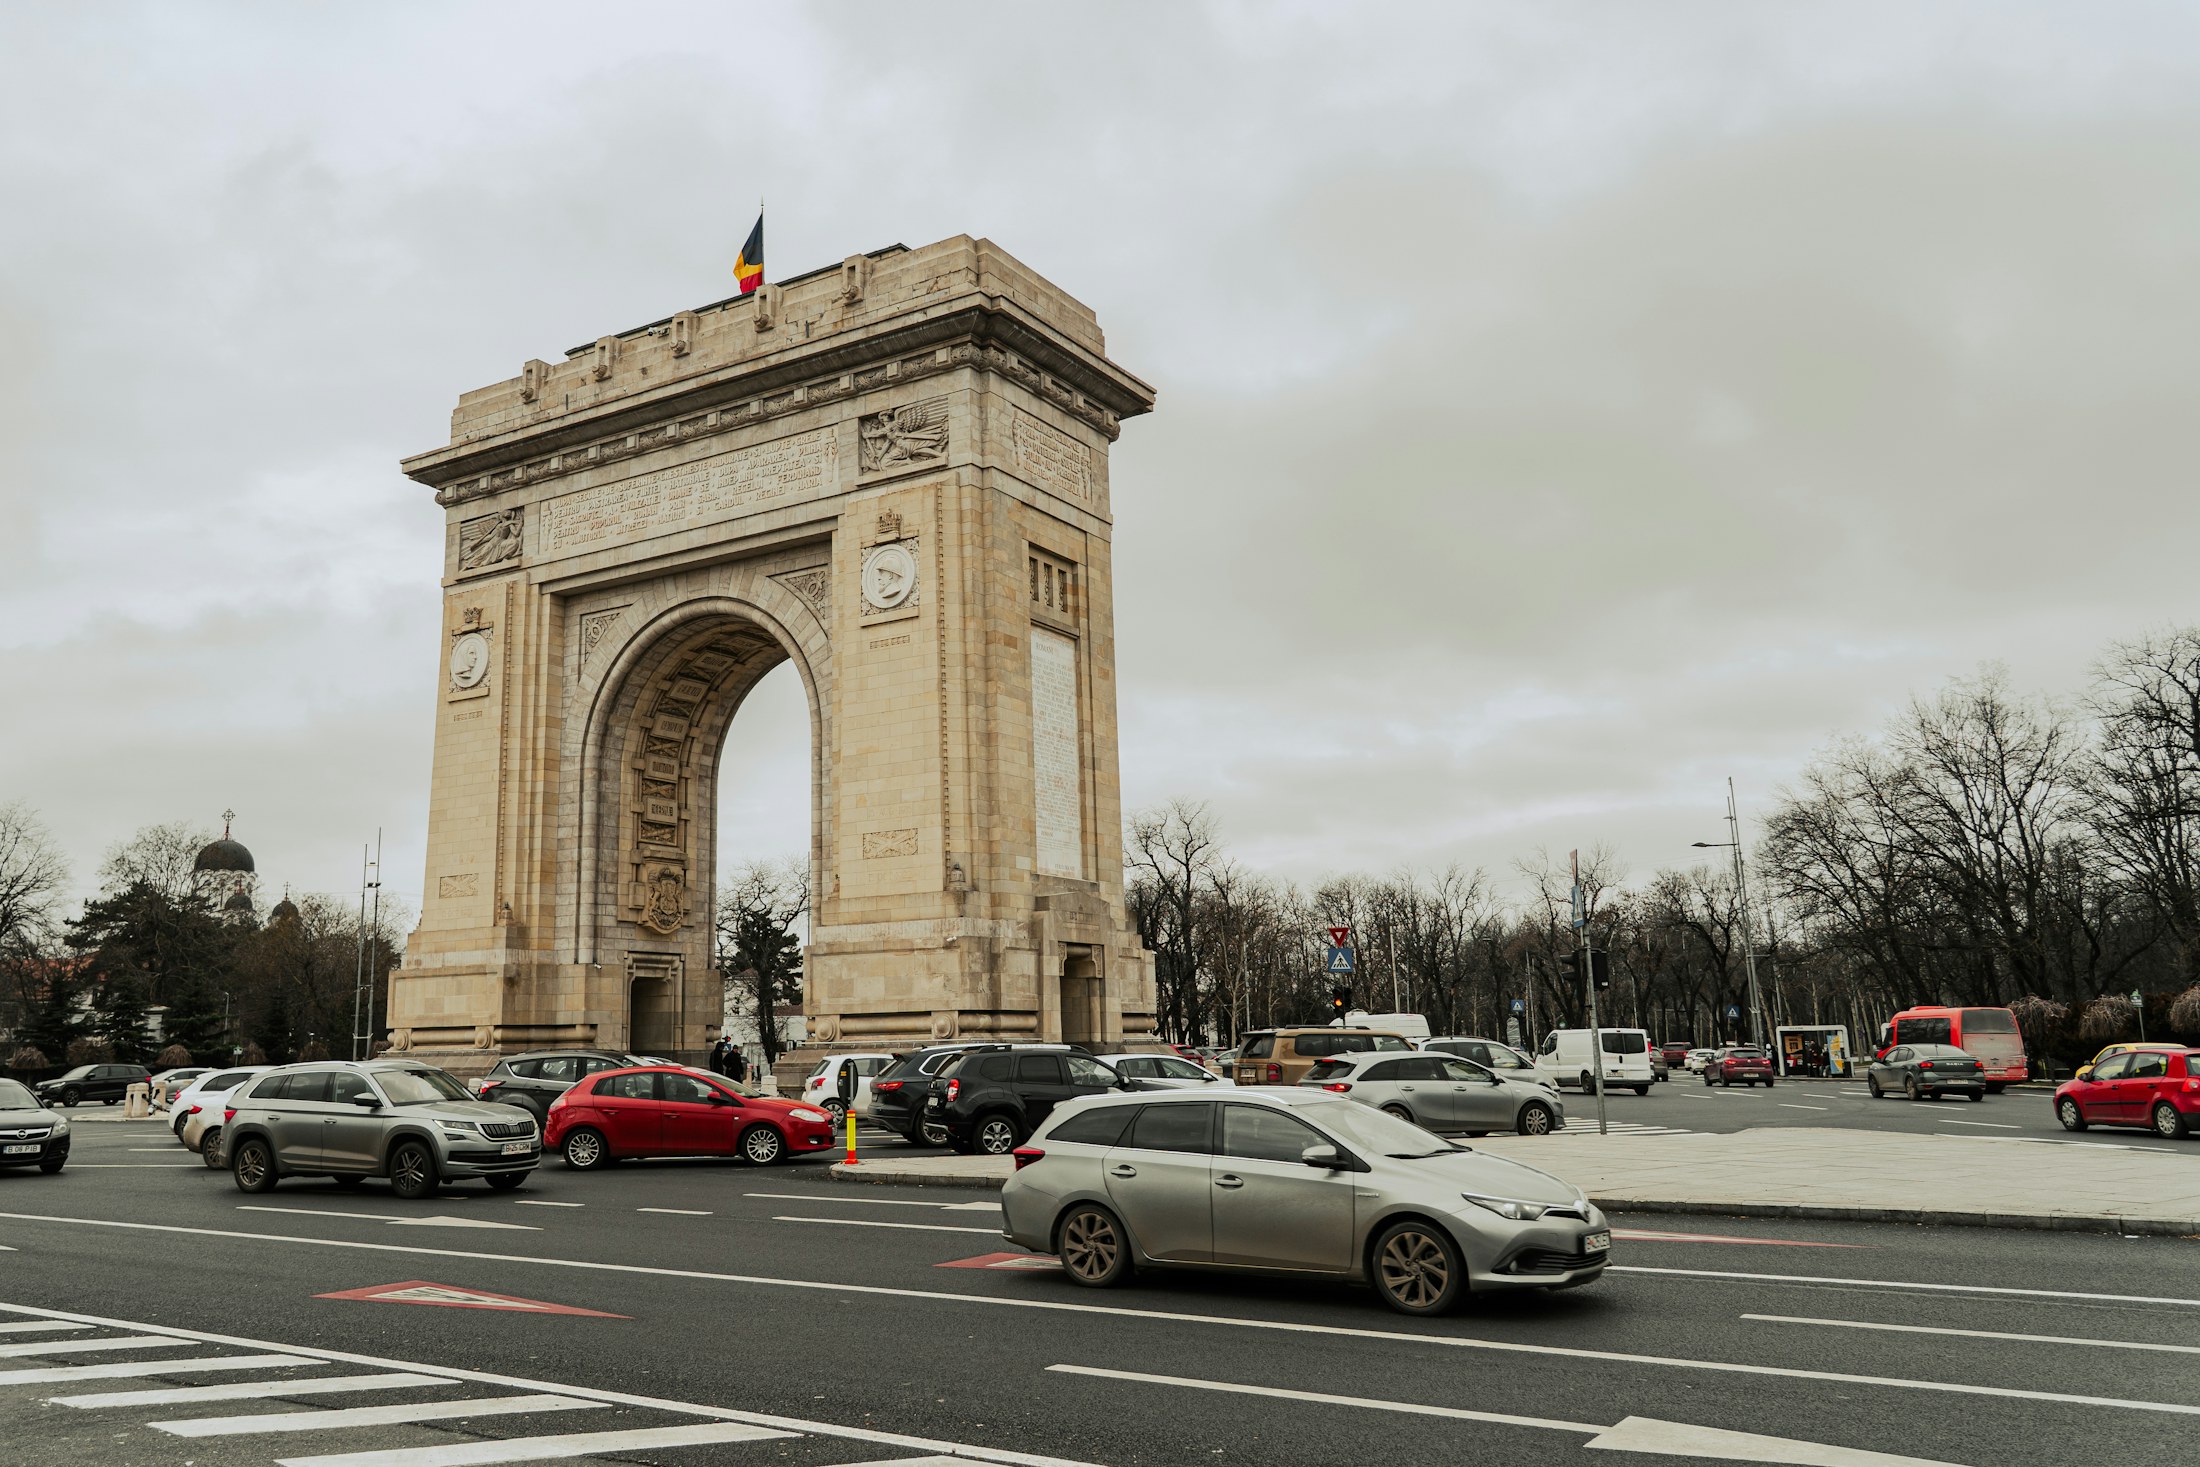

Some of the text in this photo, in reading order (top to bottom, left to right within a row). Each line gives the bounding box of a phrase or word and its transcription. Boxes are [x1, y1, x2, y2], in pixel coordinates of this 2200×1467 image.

[553, 505, 580, 519] PENTRU
[798, 442, 822, 457] PLINA
[553, 520, 563, 529] DE
[700, 483, 709, 493] SE
[762, 458, 805, 477] DREPTATEA
[553, 526, 579, 539] PENTRU
[590, 515, 622, 530] POPORUL
[668, 499, 685, 511] PRIN
[698, 491, 719, 504] SABIA
[732, 480, 763, 495] REGELUI
[777, 465, 821, 484] FERDINAND
[575, 489, 601, 503] SECOLE
[605, 486, 614, 495] DE
[619, 474, 657, 492] SUFERINTE
[765, 439, 791, 454] LUPTE
[796, 431, 821, 446] GRELE
[553, 540, 562, 549] CU
[755, 485, 785, 501] REGINEI
